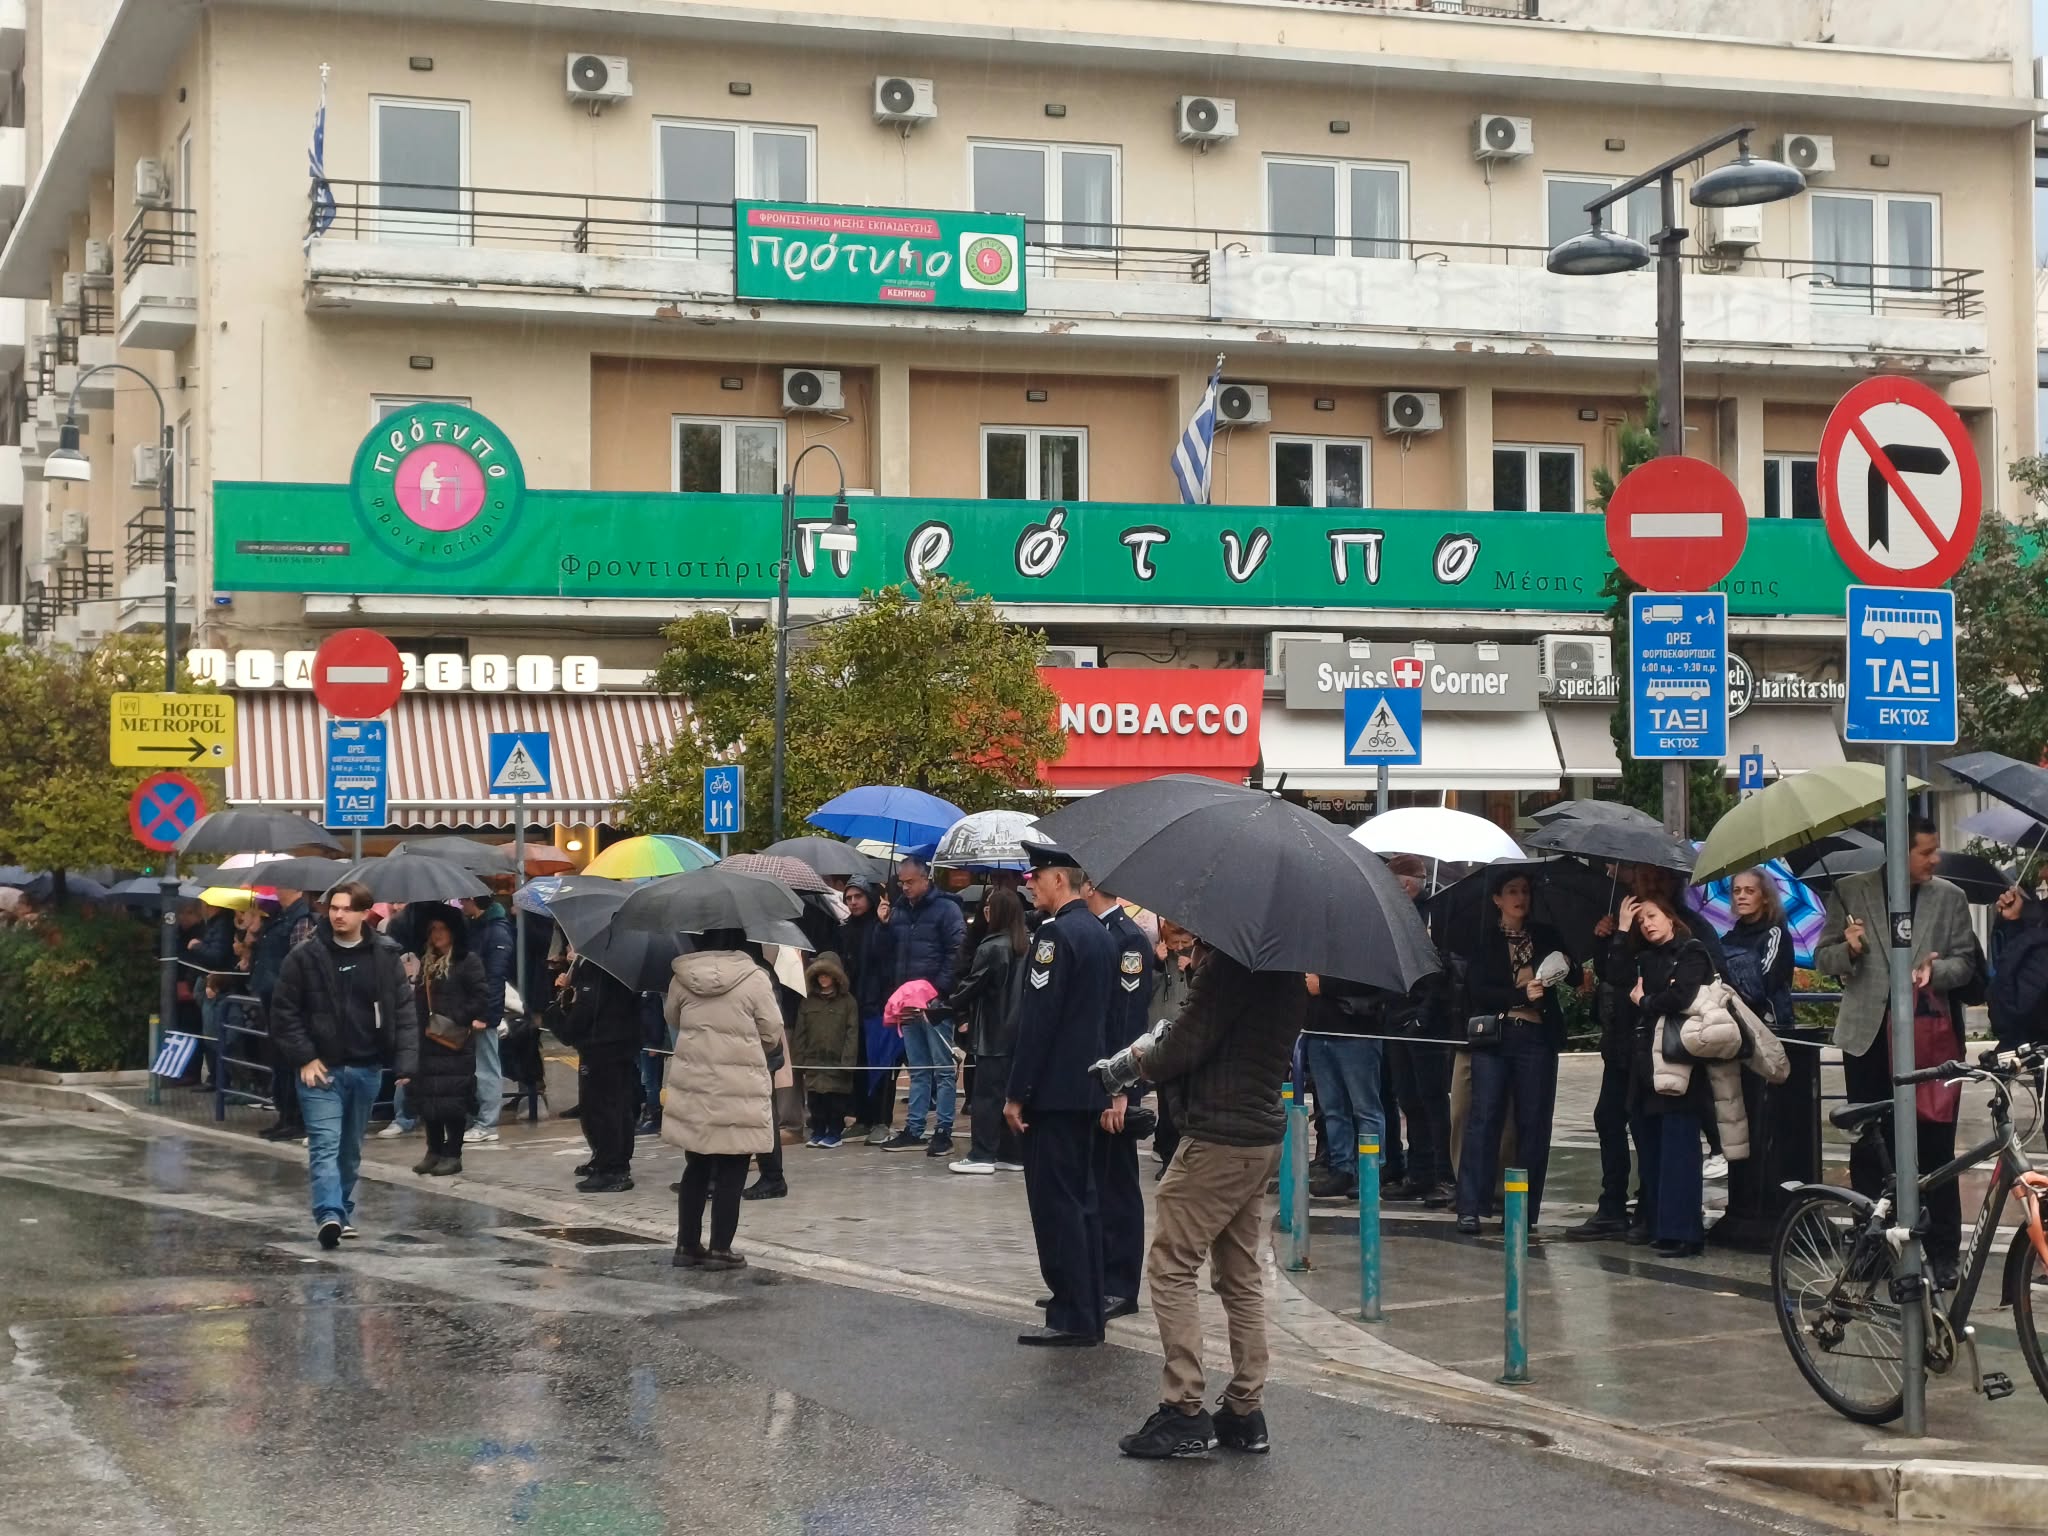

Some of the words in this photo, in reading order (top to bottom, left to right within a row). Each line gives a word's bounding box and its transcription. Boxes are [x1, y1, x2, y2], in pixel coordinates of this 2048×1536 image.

[759, 212, 831, 227] ΦΡΟΝΤΙΣΤΗΡΙΟ
[833, 218, 865, 229] ΜΕΣΗΣ
[868, 220, 934, 234] ΕΚΠΑΙΔΕΥΣΗΣ
[887, 288, 926, 299] ΚΕΝΤΡΙΚΟ
[1493, 570, 1583, 594] Μέσης
[1666, 632, 1692, 645] ΩΡΕΣ
[1683, 662, 1701, 672] 9:30
[1317, 662, 1389, 692] Swiss
[1430, 664, 1509, 695] Corner
[1865, 658, 1940, 695] ΤΑΞΙ
[1762, 678, 1817, 699] barista
[1820, 678, 1845, 699] sho
[162, 702, 226, 718] HOTEL
[1059, 702, 1249, 736] NOBACCO
[1879, 708, 1930, 726] ΕΚΤΟΣ
[120, 718, 226, 733] METROPOL
[1649, 709, 1708, 730] ΤΑΞΙ
[1659, 738, 1700, 748] ΕΚΤΟΣ
[1745, 759, 1758, 785] P
[335, 795, 375, 810] ΤΑΞΙ
[1307, 799, 1331, 811] Swiss
[1345, 800, 1373, 811] Corner
